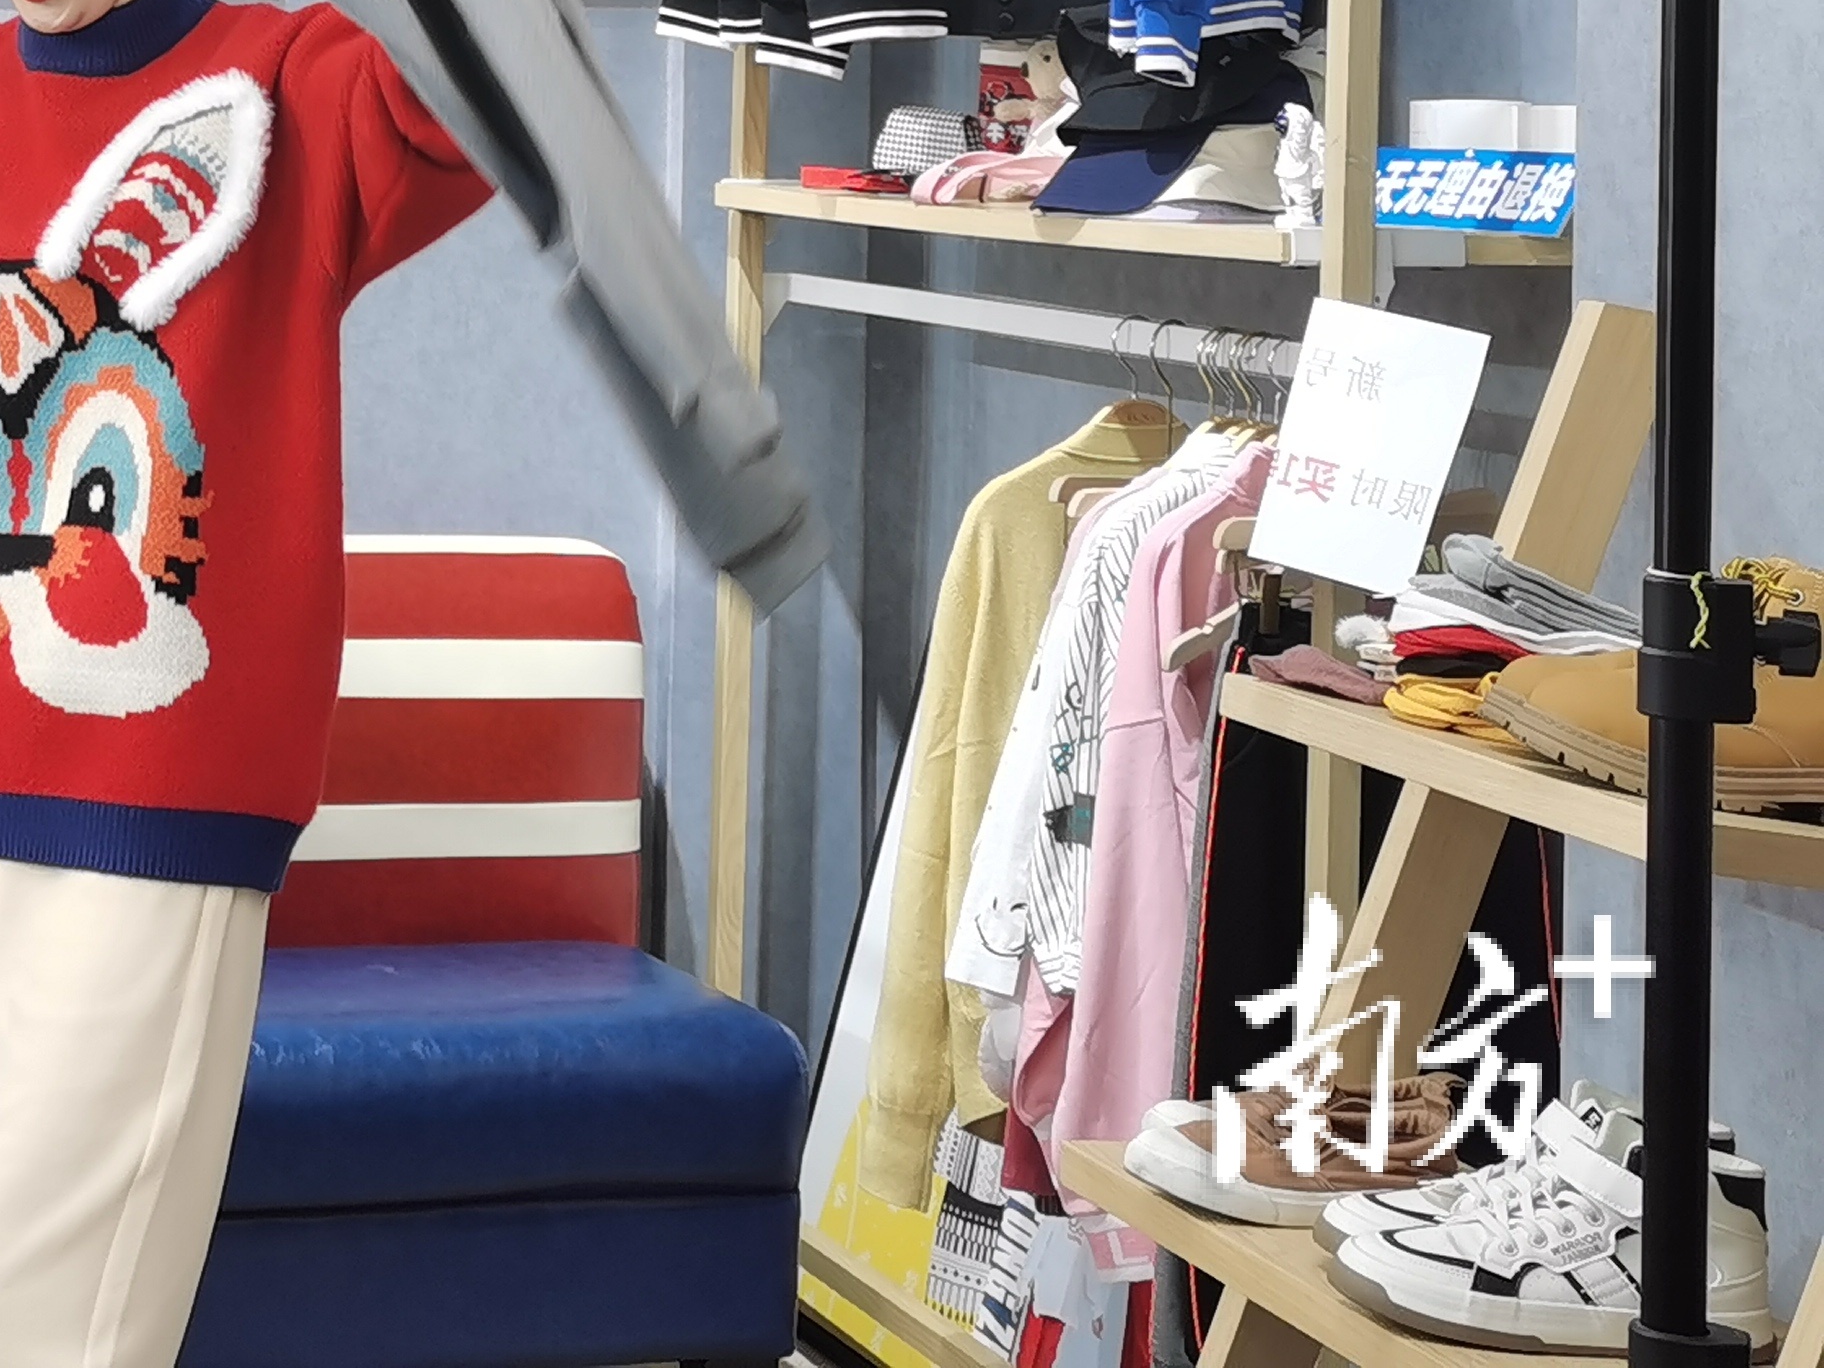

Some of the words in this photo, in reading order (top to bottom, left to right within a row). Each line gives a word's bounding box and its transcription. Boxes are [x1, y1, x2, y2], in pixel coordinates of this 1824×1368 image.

[1375, 159, 1575, 223] 天无理由退换
